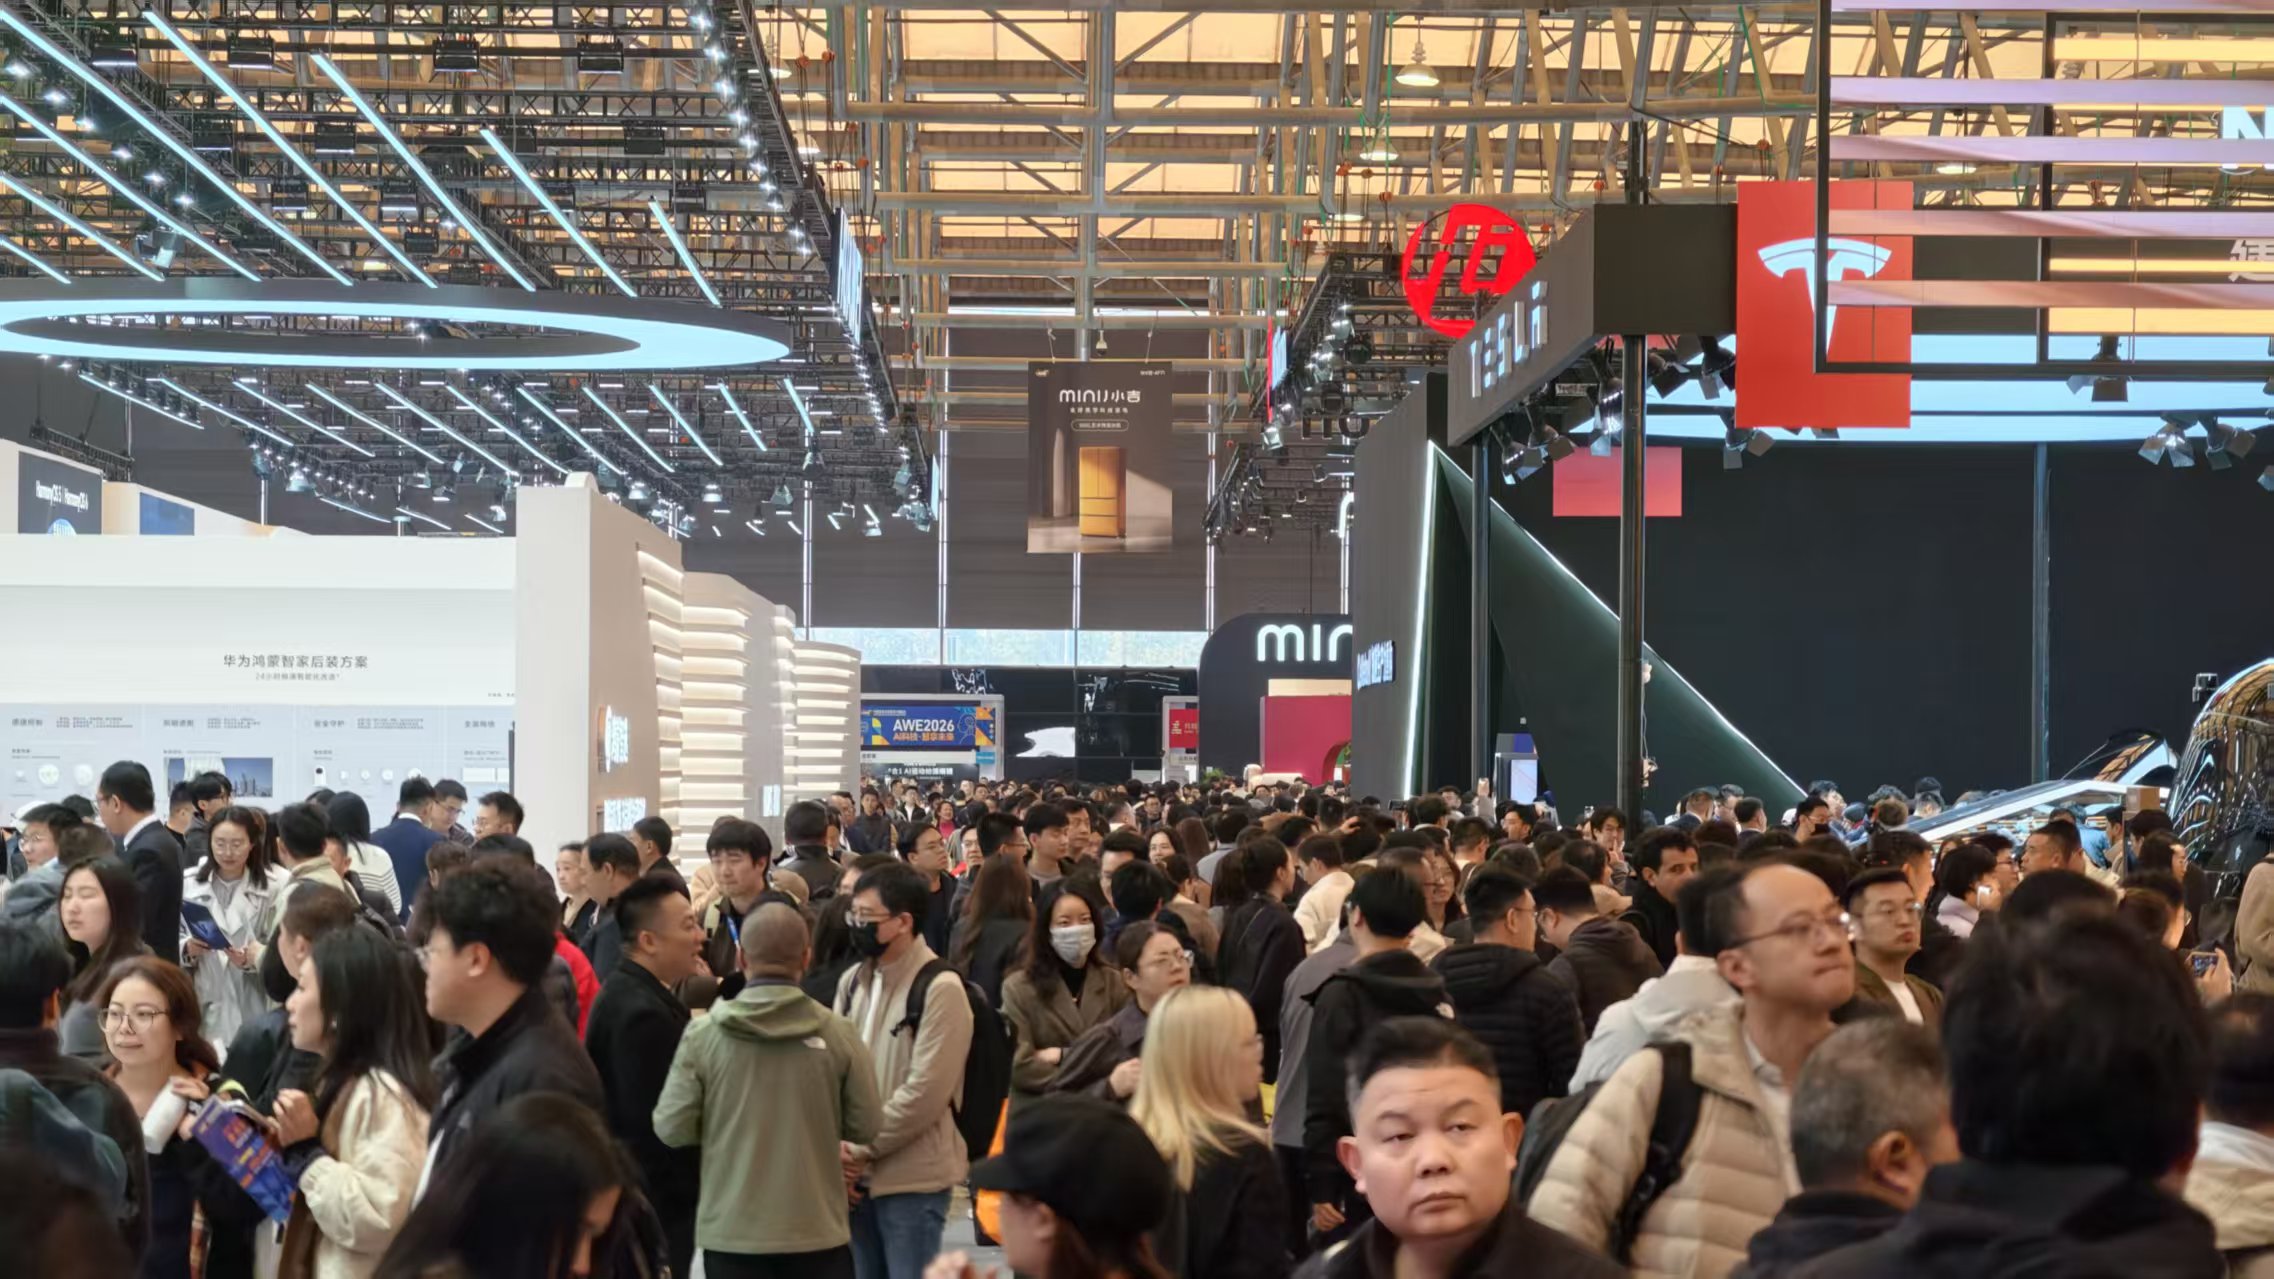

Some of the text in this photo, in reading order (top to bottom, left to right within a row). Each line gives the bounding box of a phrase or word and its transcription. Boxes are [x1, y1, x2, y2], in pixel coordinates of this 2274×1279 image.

[223, 654, 368, 668] 华为鸿蒙智家后装方案
[893, 719, 955, 732] AWE2026
